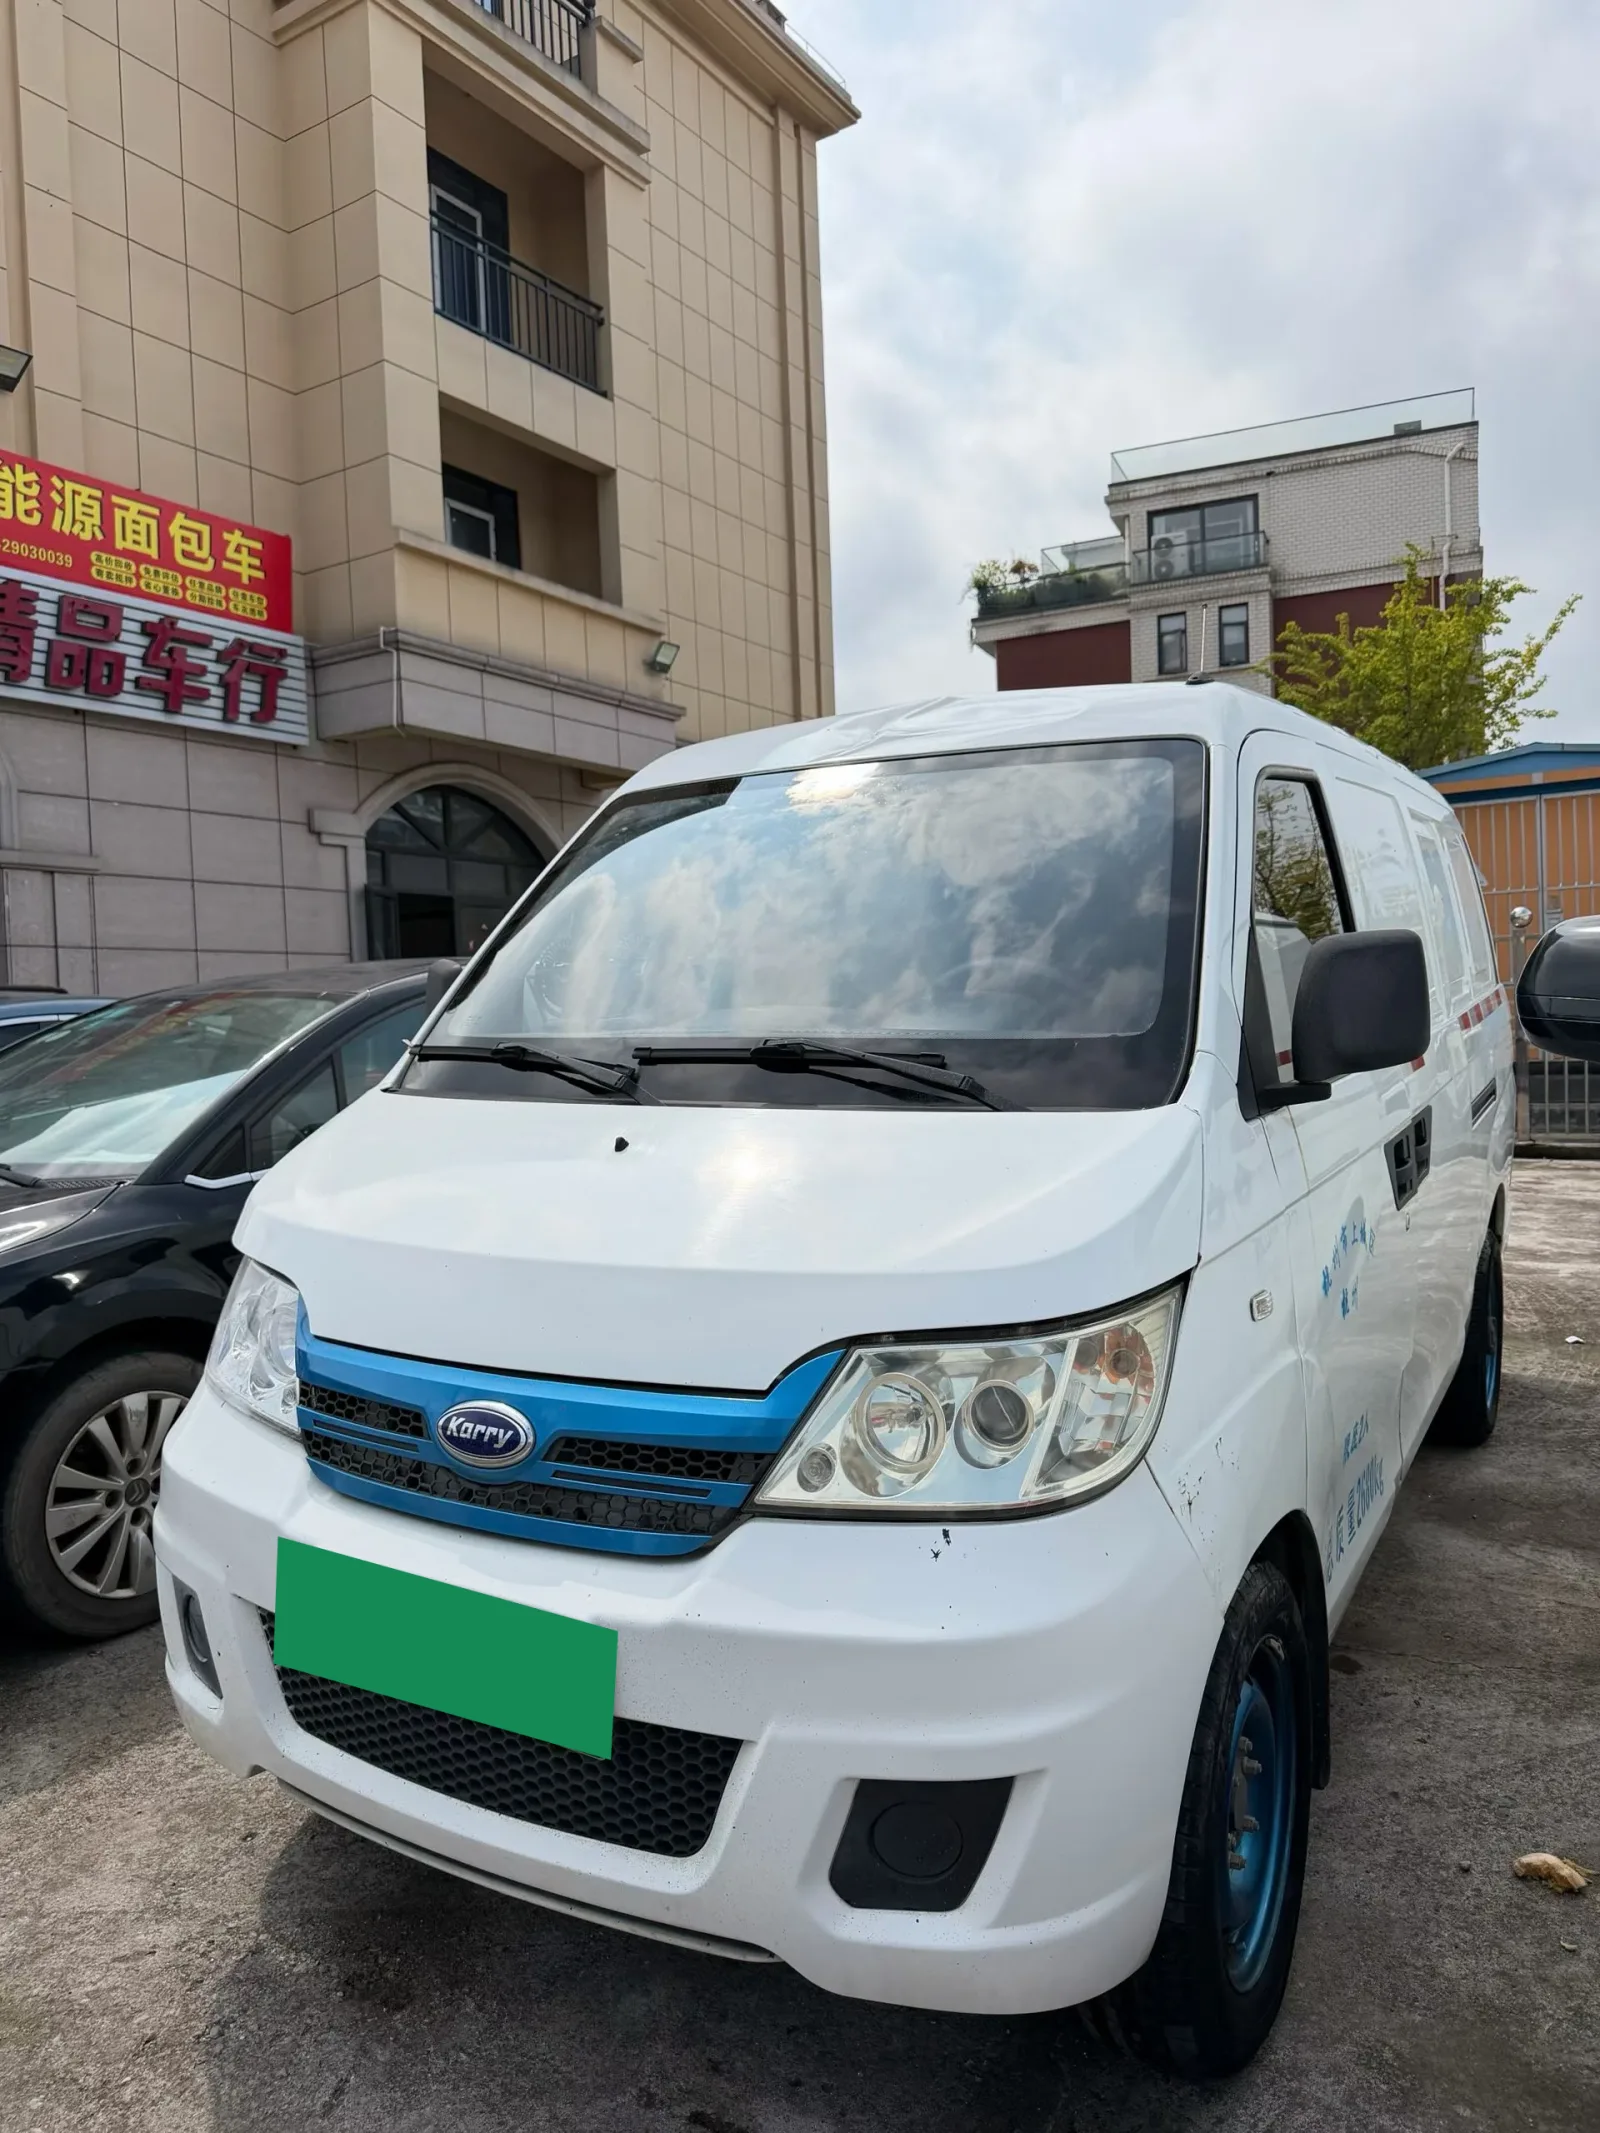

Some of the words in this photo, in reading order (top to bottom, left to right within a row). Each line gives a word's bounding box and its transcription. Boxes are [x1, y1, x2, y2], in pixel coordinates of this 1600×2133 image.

[0, 461, 266, 585] 能源面包车
[446, 1416, 514, 1449] Karry
